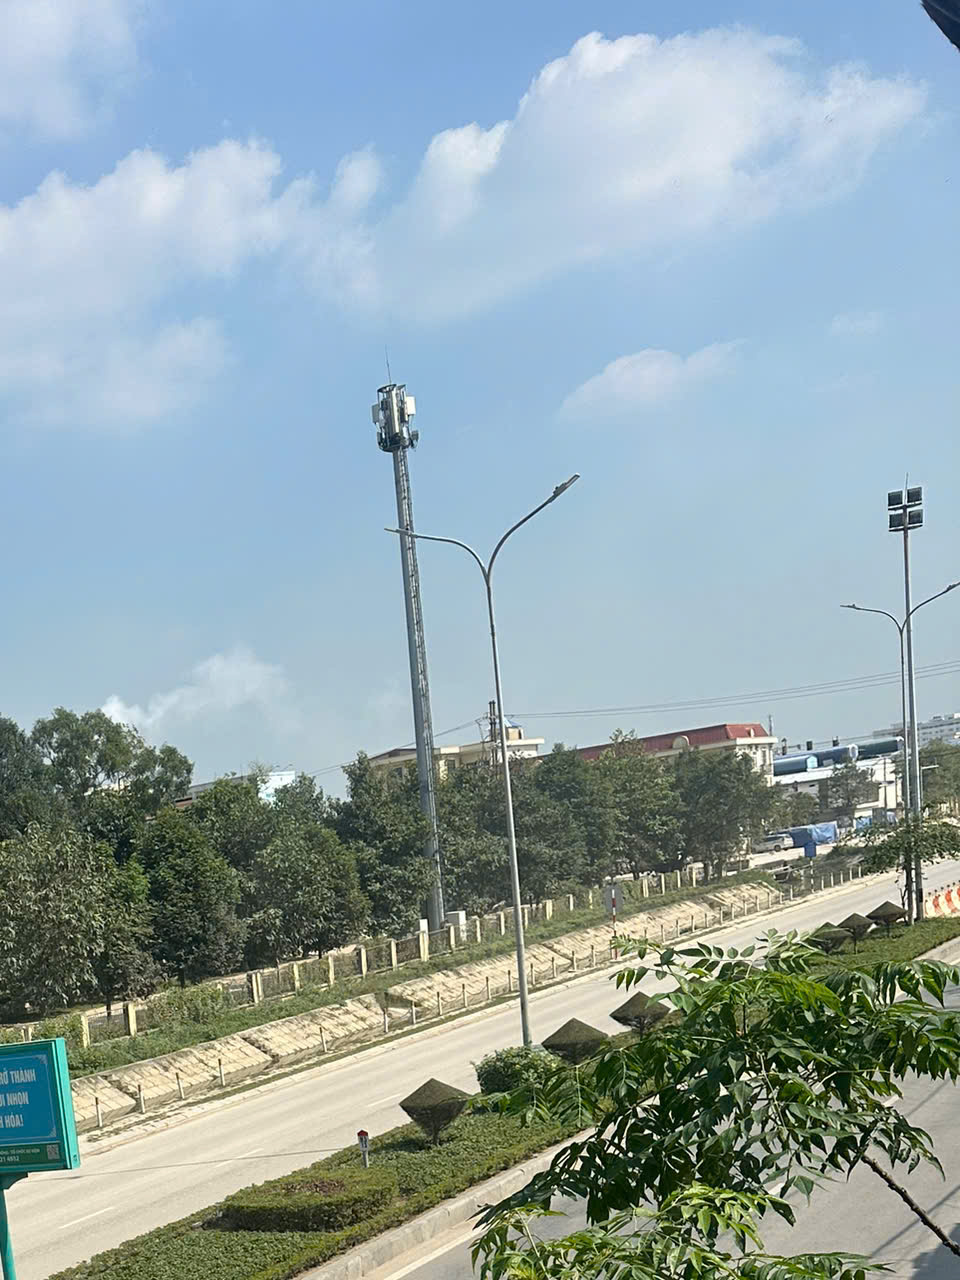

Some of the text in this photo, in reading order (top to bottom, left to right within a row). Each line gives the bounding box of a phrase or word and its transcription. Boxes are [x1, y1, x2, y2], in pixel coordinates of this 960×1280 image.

[10, 1068, 36, 1084] THÀNH
[6, 1091, 29, 1109] NHỌN
[4, 1112, 24, 1129] HÓA!
